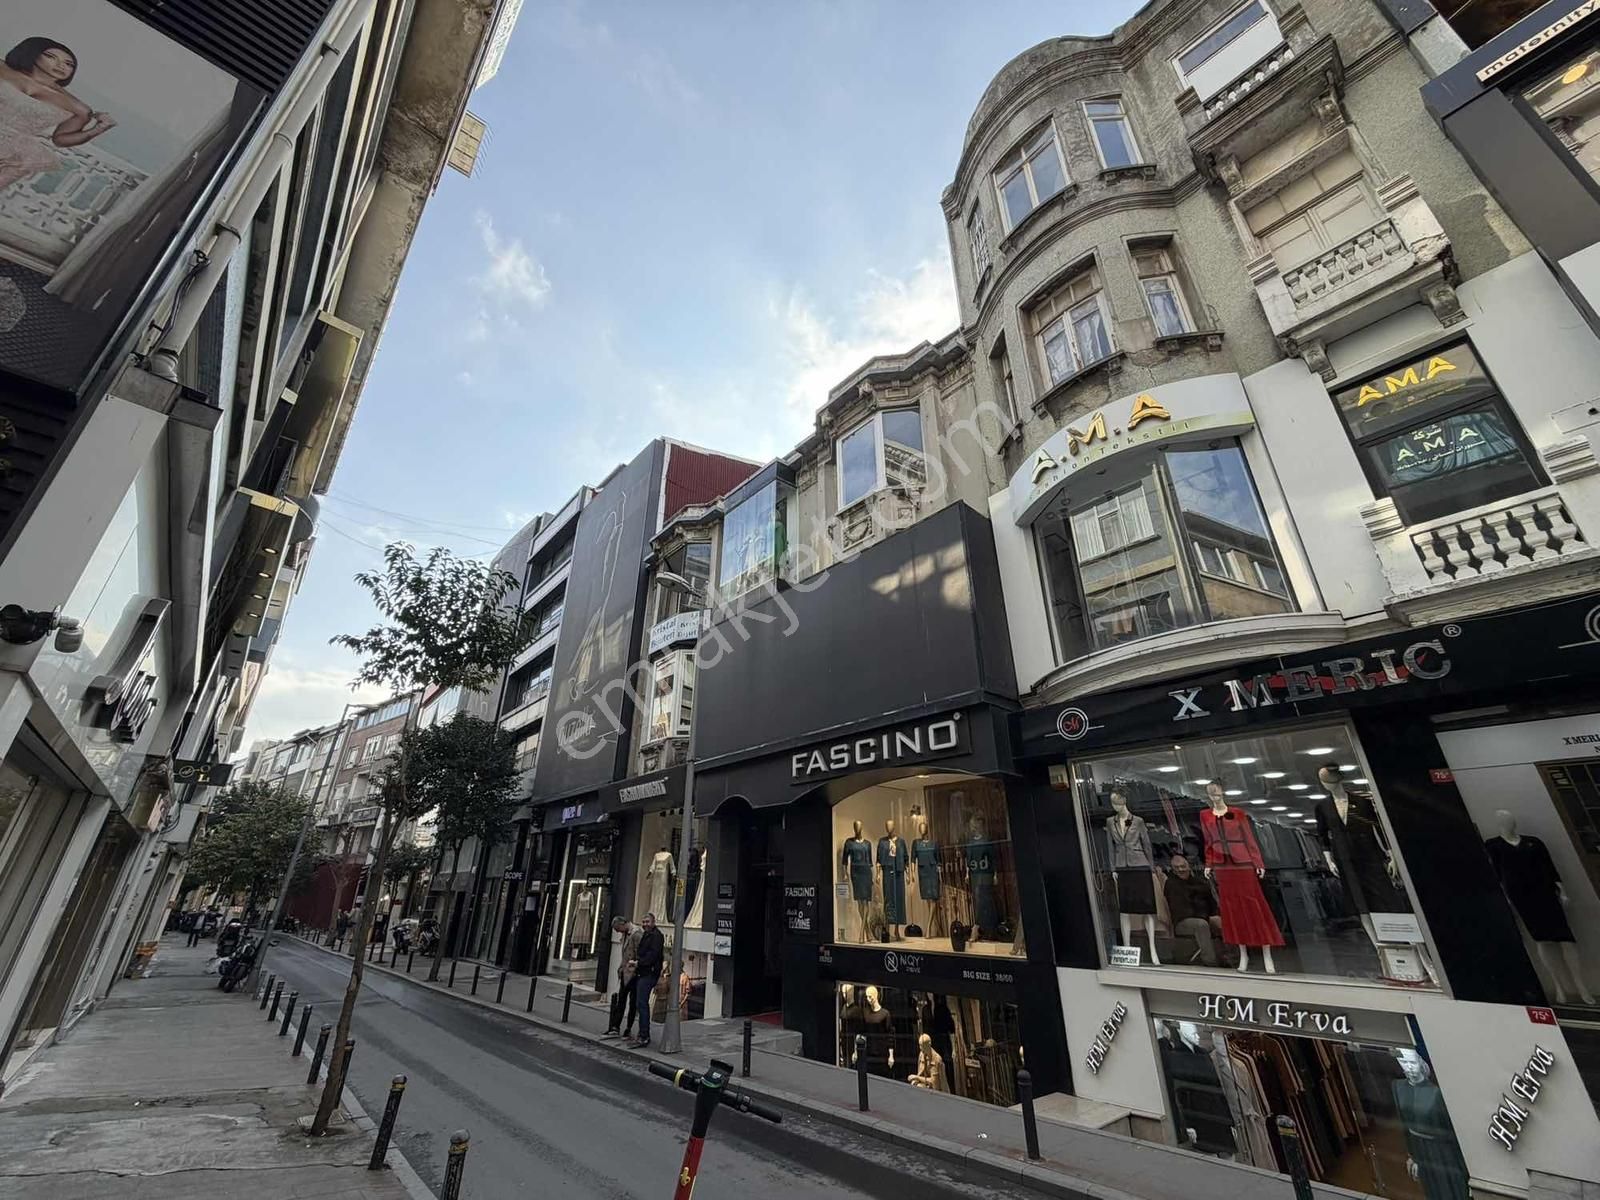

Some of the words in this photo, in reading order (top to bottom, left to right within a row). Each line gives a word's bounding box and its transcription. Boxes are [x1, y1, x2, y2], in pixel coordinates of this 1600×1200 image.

[1484, 0, 1598, 76] maternity
[1099, 420, 1191, 455] Tekstil
[1168, 687, 1211, 721] X
[791, 719, 958, 778] FASCINO
[504, 871, 523, 880] SCOPE
[784, 887, 815, 897] FASCINO
[963, 970, 975, 979] BIG
[975, 971, 991, 981] SIZE
[1198, 994, 1258, 1025] HM
[1267, 1002, 1353, 1036] Erva
[1085, 1034, 1110, 1076] HM
[1101, 1000, 1128, 1042] Erva
[1487, 1093, 1530, 1154] HM
[1510, 1044, 1556, 1104] Erva
